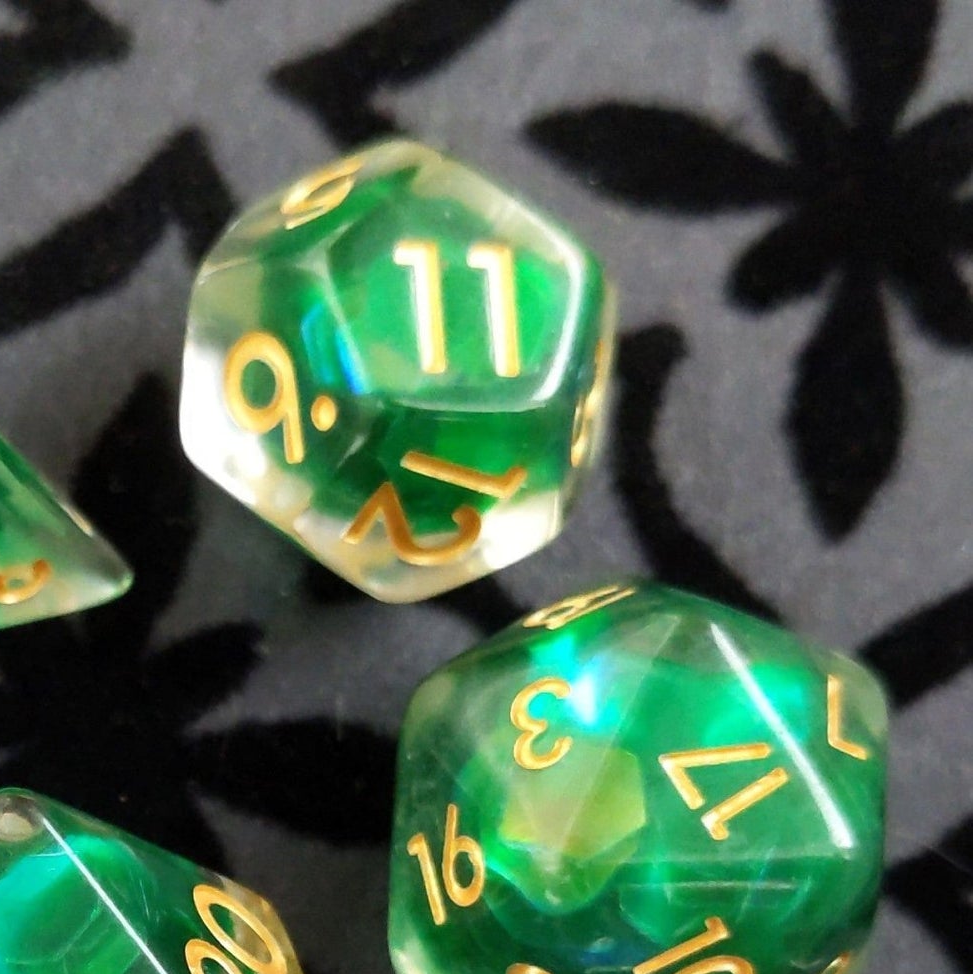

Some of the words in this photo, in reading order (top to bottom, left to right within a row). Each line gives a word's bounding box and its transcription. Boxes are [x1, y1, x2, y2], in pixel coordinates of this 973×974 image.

[392, 239, 522, 378] 11
[340, 450, 527, 566] 12
[510, 677, 573, 770] 3
[658, 742, 790, 841] 17
[406, 804, 486, 926] 16
